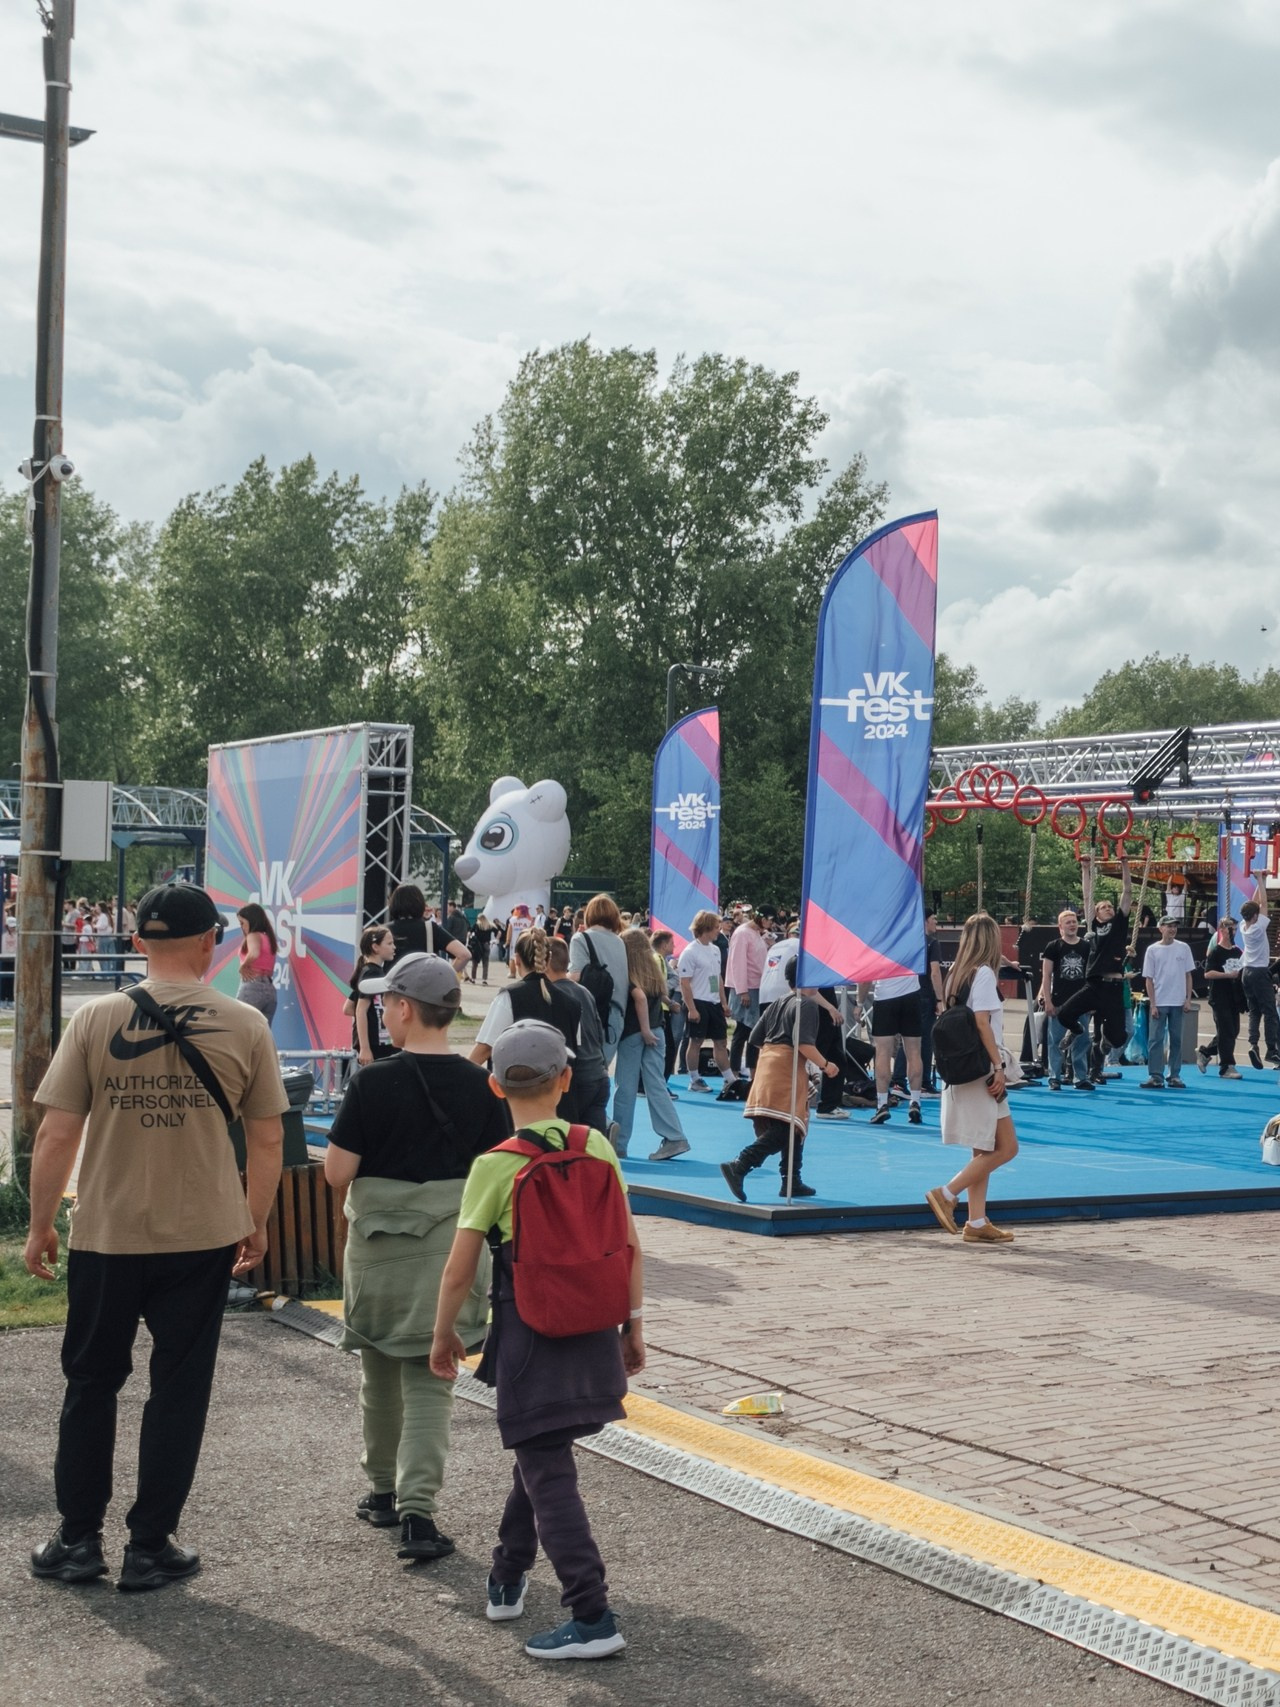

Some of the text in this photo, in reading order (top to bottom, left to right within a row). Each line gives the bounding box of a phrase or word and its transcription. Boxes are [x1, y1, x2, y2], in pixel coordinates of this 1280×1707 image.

[863, 671, 911, 696] VK
[847, 688, 931, 723] fest
[863, 723, 909, 739] 2024
[678, 793, 706, 807] VK
[669, 801, 716, 821] fest
[678, 821, 706, 830] 2024
[259, 860, 296, 906] VK
[104, 1075, 205, 1091] AUTHORIZE
[110, 1094, 216, 1110] PERSONNEL
[140, 1113, 187, 1128] ONLY
